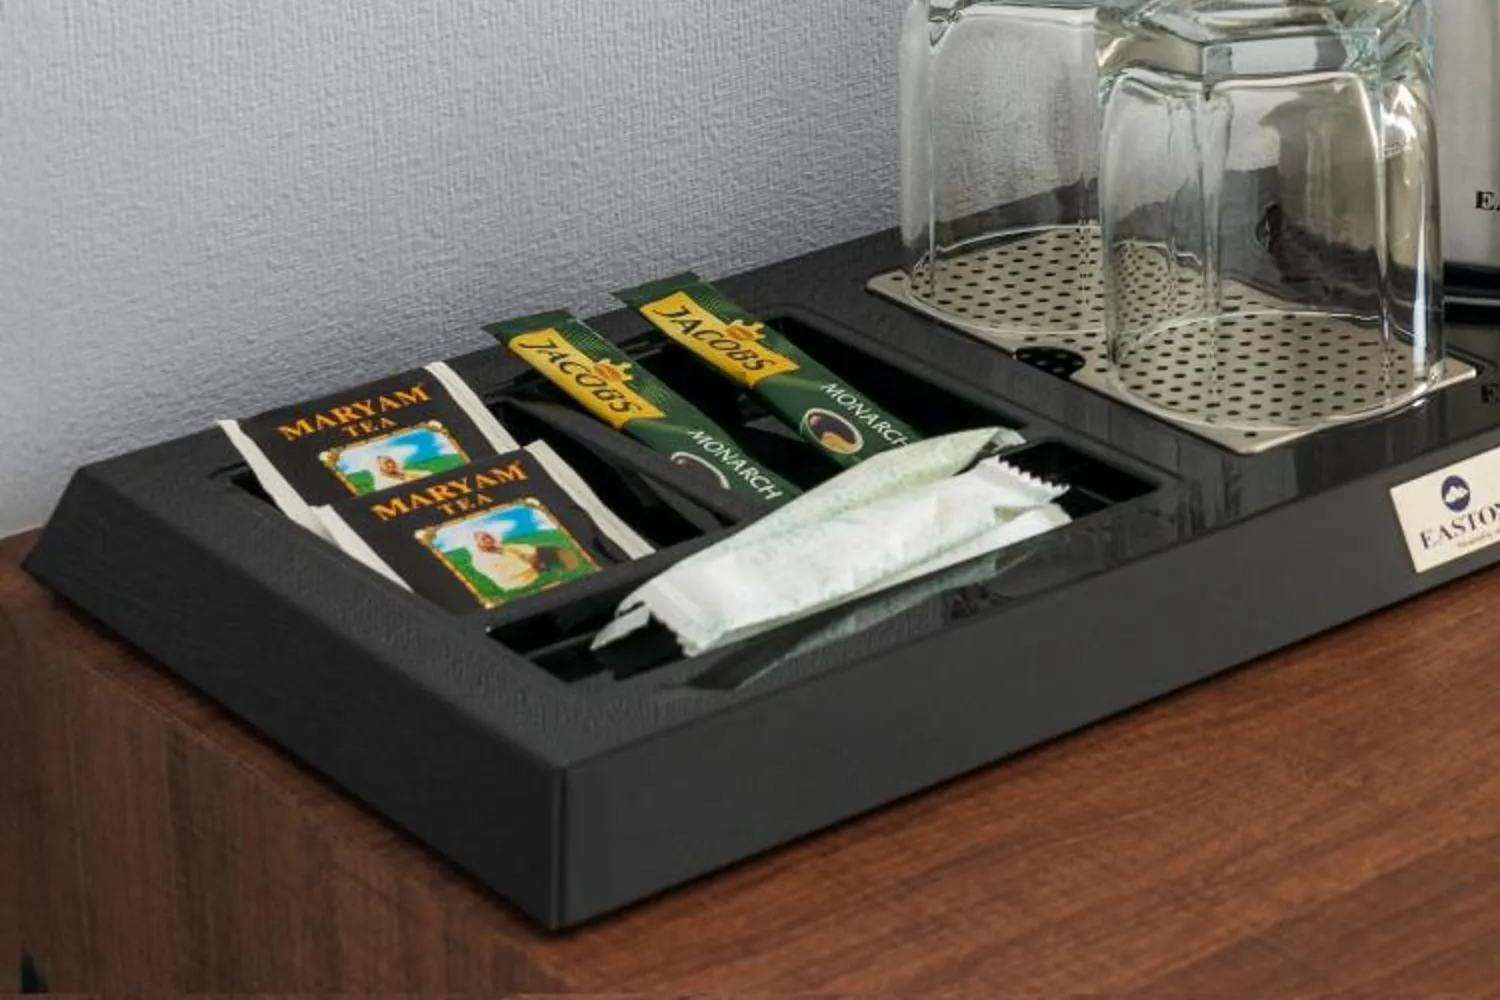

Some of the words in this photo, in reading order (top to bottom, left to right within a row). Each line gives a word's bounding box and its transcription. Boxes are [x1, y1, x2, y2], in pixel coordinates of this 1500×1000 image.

[651, 304, 776, 372] JACOBS
[518, 338, 642, 414] JACOBS
[277, 383, 433, 442] MARYAM
[342, 417, 397, 438] TEA
[371, 460, 528, 522] MARYAM
[687, 430, 784, 500] MONARCH
[437, 493, 493, 516] TEA
